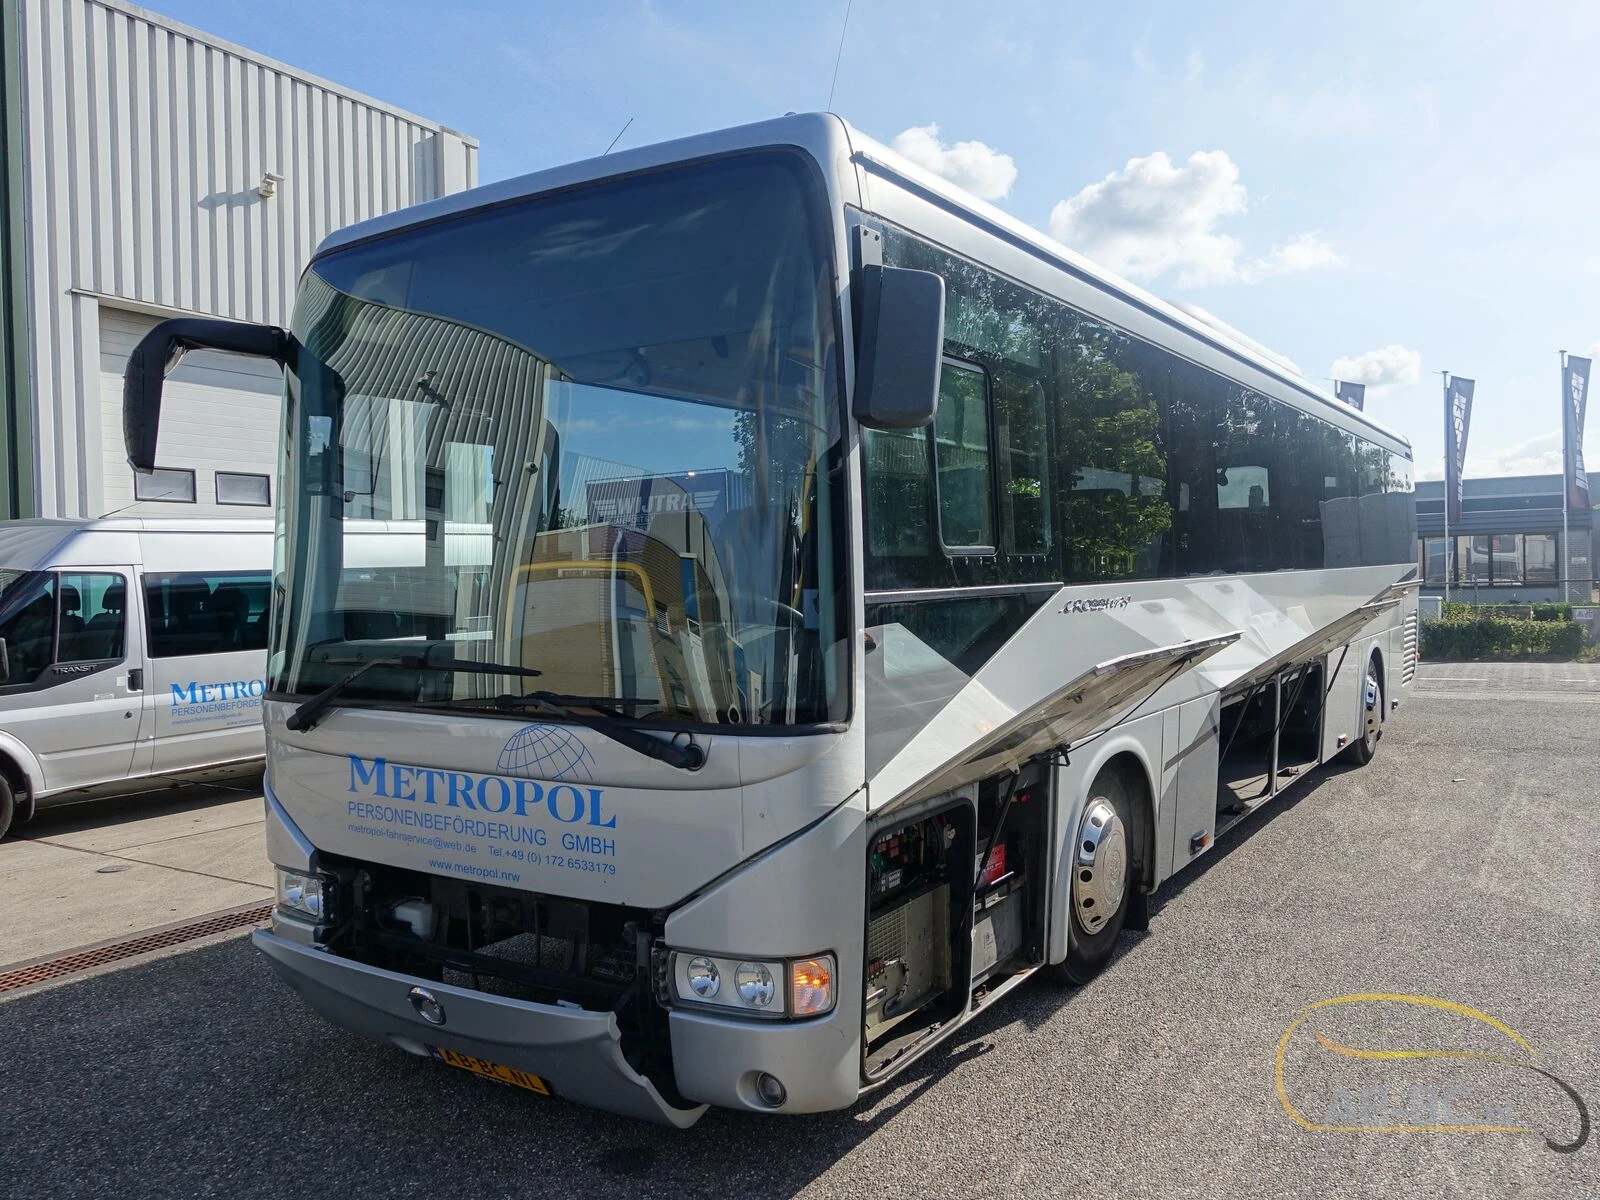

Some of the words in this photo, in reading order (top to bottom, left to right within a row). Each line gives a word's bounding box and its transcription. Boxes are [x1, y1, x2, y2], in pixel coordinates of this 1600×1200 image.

[617, 493, 695, 515] WIJTRA
[52, 664, 97, 675] TRANSIT
[169, 679, 265, 706] METRO
[347, 753, 616, 829] METROPOL
[348, 801, 547, 846] PERSONENBEFÖRDERUNG
[561, 832, 616, 857] GMBH
[348, 823, 477, 853] metropol-fahrservice@web.de
[527, 850, 542, 866] (0)
[545, 854, 564, 867] 172
[567, 857, 616, 875] 6533179
[428, 858, 521, 883] www.metropol.nrw
